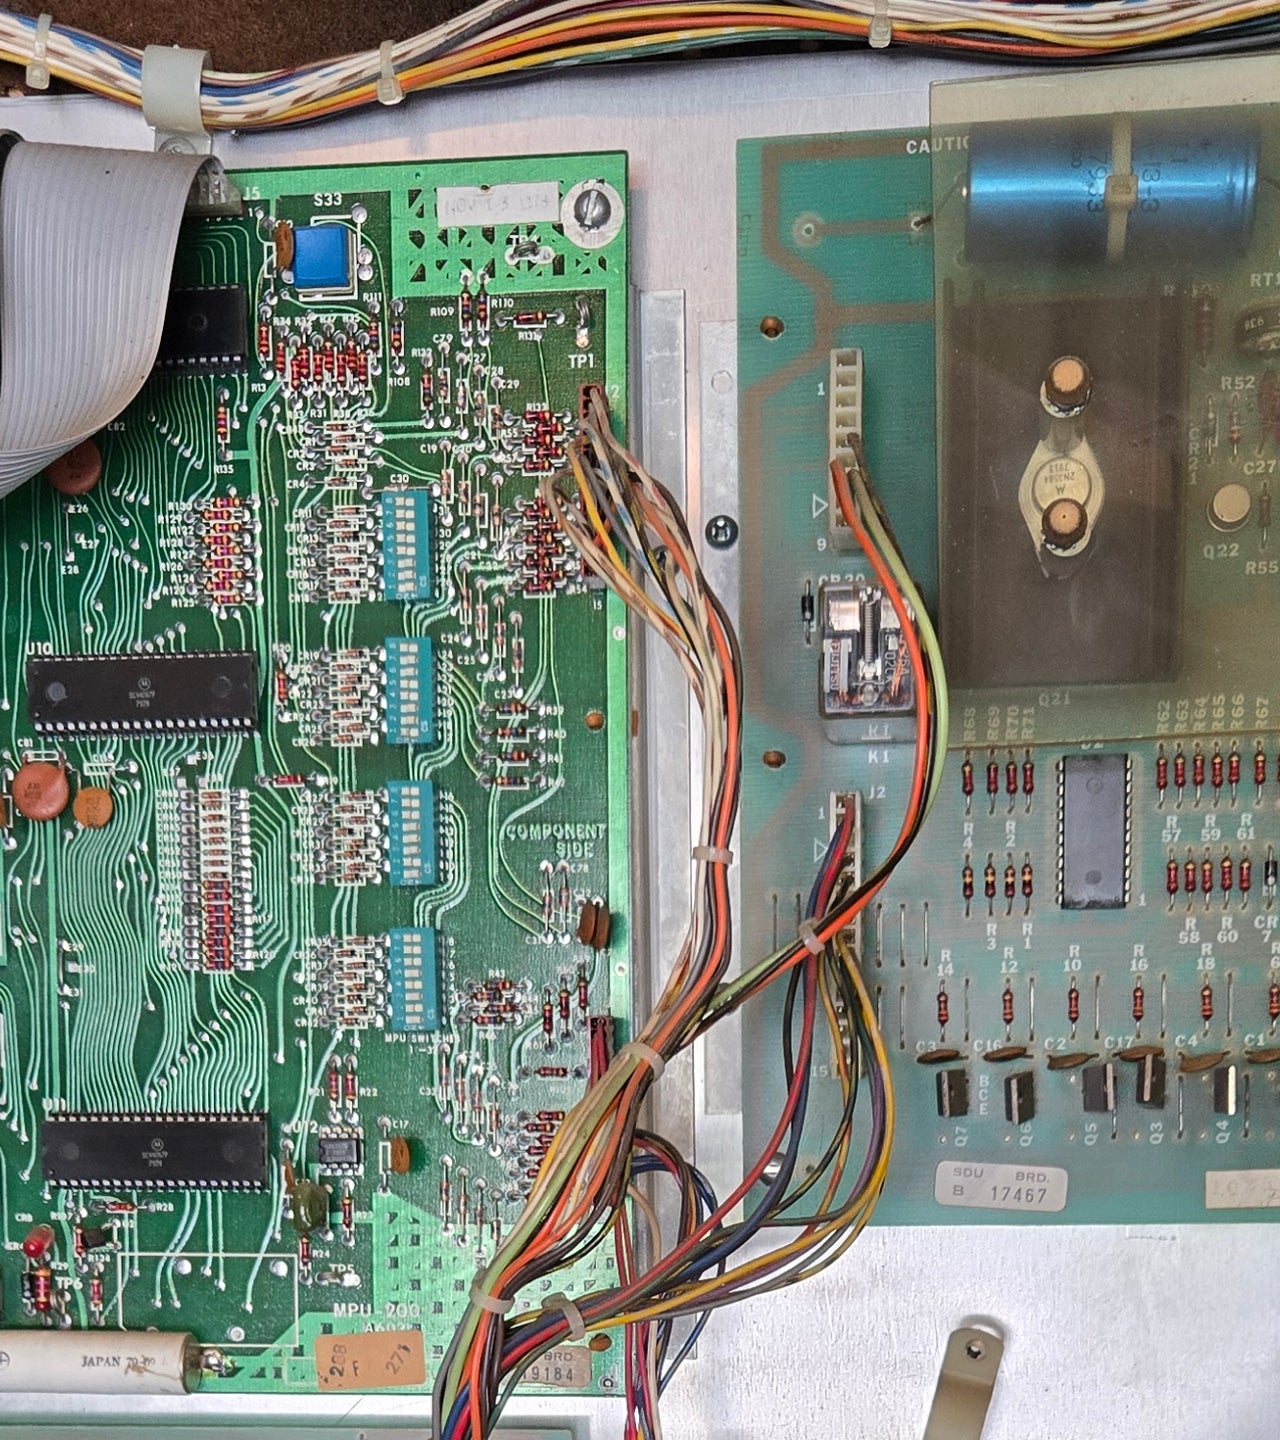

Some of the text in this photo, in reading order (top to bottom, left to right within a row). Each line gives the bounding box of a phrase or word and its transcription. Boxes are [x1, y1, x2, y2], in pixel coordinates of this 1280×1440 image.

[309, 188, 347, 207] S33
[567, 352, 594, 369] TP1
[506, 822, 607, 842] COMPONENT
[555, 841, 595, 862] SIDE
[332, 1302, 421, 1318] MPU-200
[81, 1355, 121, 1368] JAPAN
